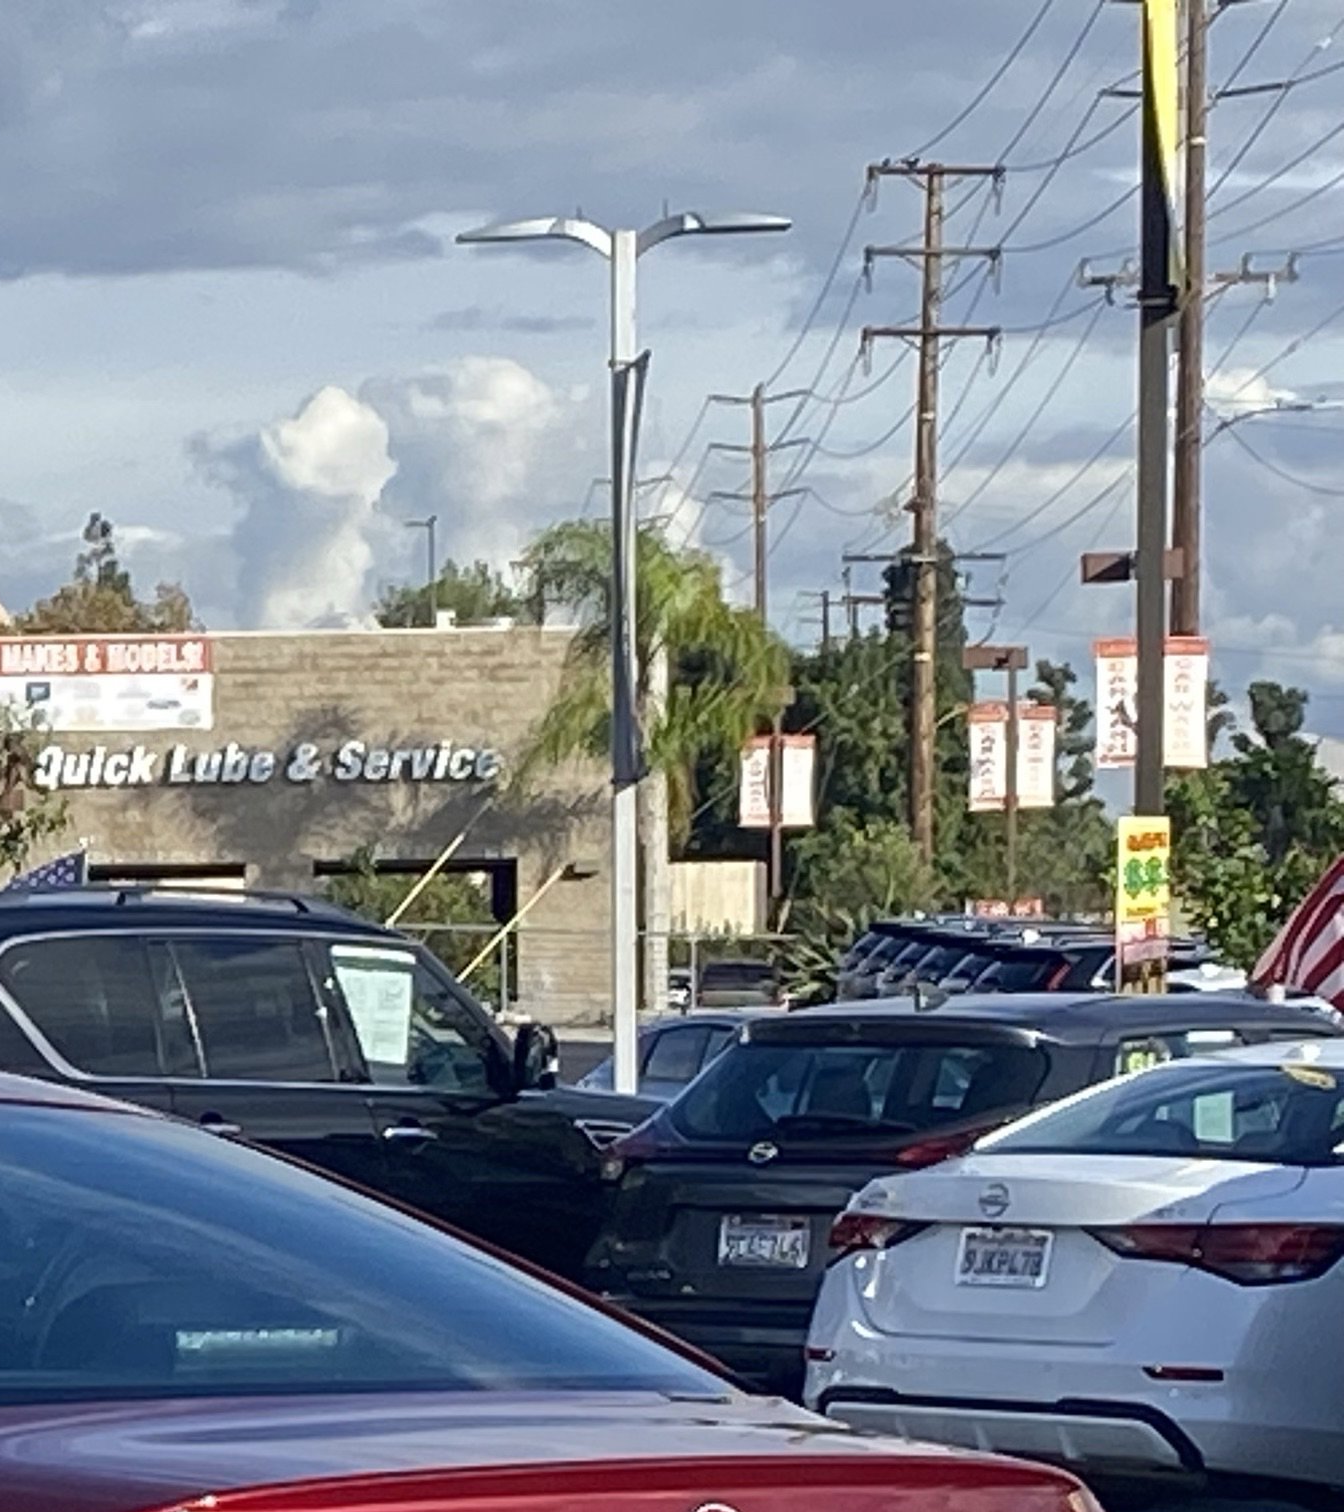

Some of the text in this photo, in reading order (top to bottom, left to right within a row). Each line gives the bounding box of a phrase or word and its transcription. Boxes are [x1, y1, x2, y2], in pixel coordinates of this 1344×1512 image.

[1, 643, 79, 673] MAKES
[34, 738, 502, 791] Quick Lube & Service
